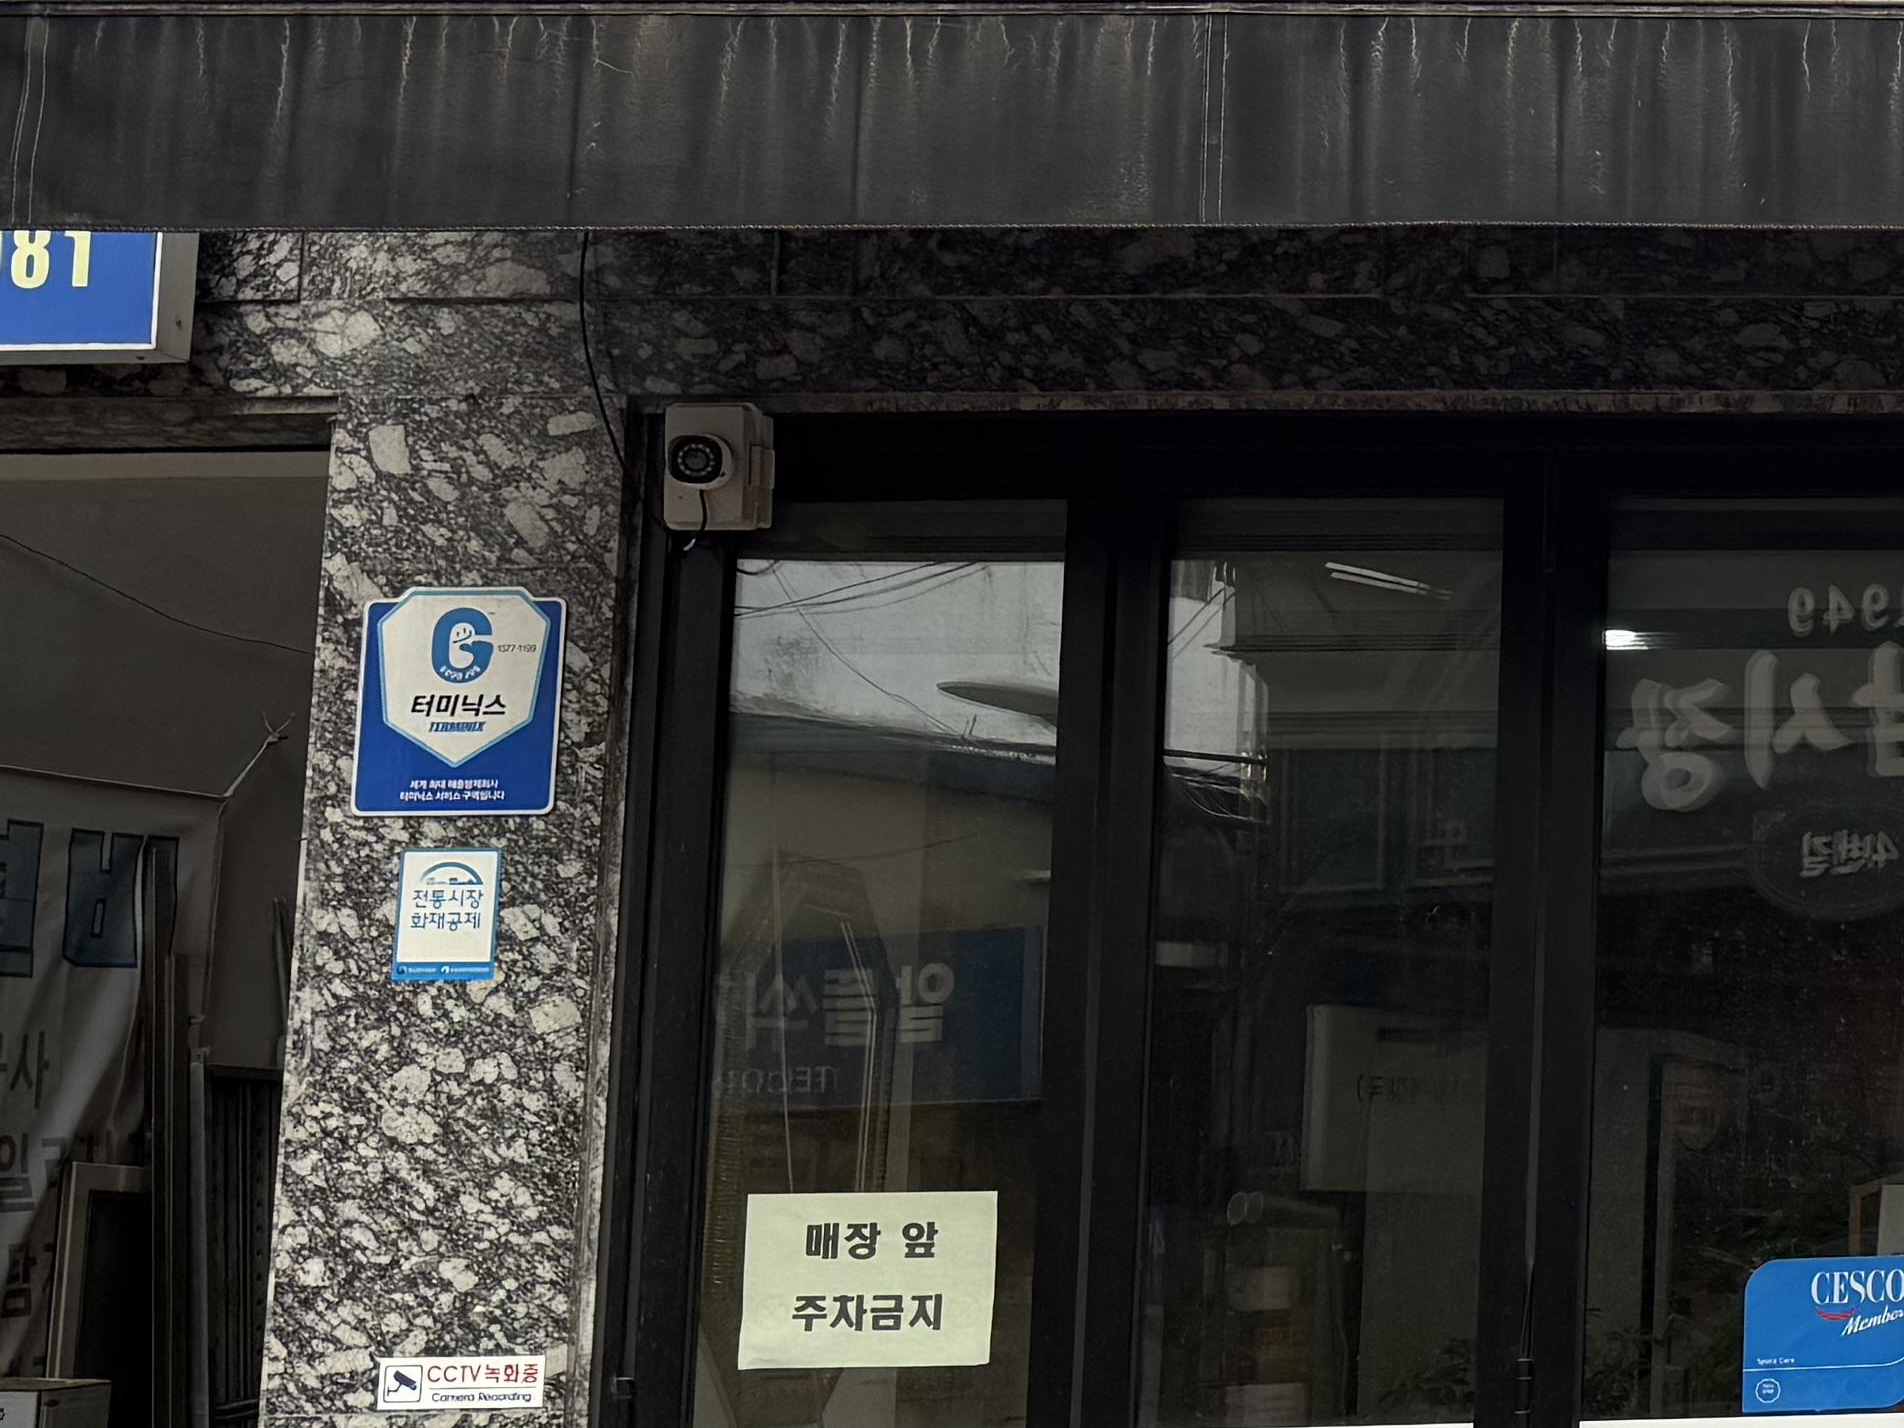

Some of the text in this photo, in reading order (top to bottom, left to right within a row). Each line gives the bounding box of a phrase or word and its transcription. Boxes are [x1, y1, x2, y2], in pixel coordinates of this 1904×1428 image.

[0, 229, 91, 289] 81
[411, 694, 506, 717] 터미닉스
[413, 890, 484, 909] 전통시장
[410, 912, 481, 931] 화재공제
[804, 1221, 938, 1261] 매장 앞
[791, 1293, 943, 1333] 주차금지
[431, 1392, 532, 1403] Camera Recording
